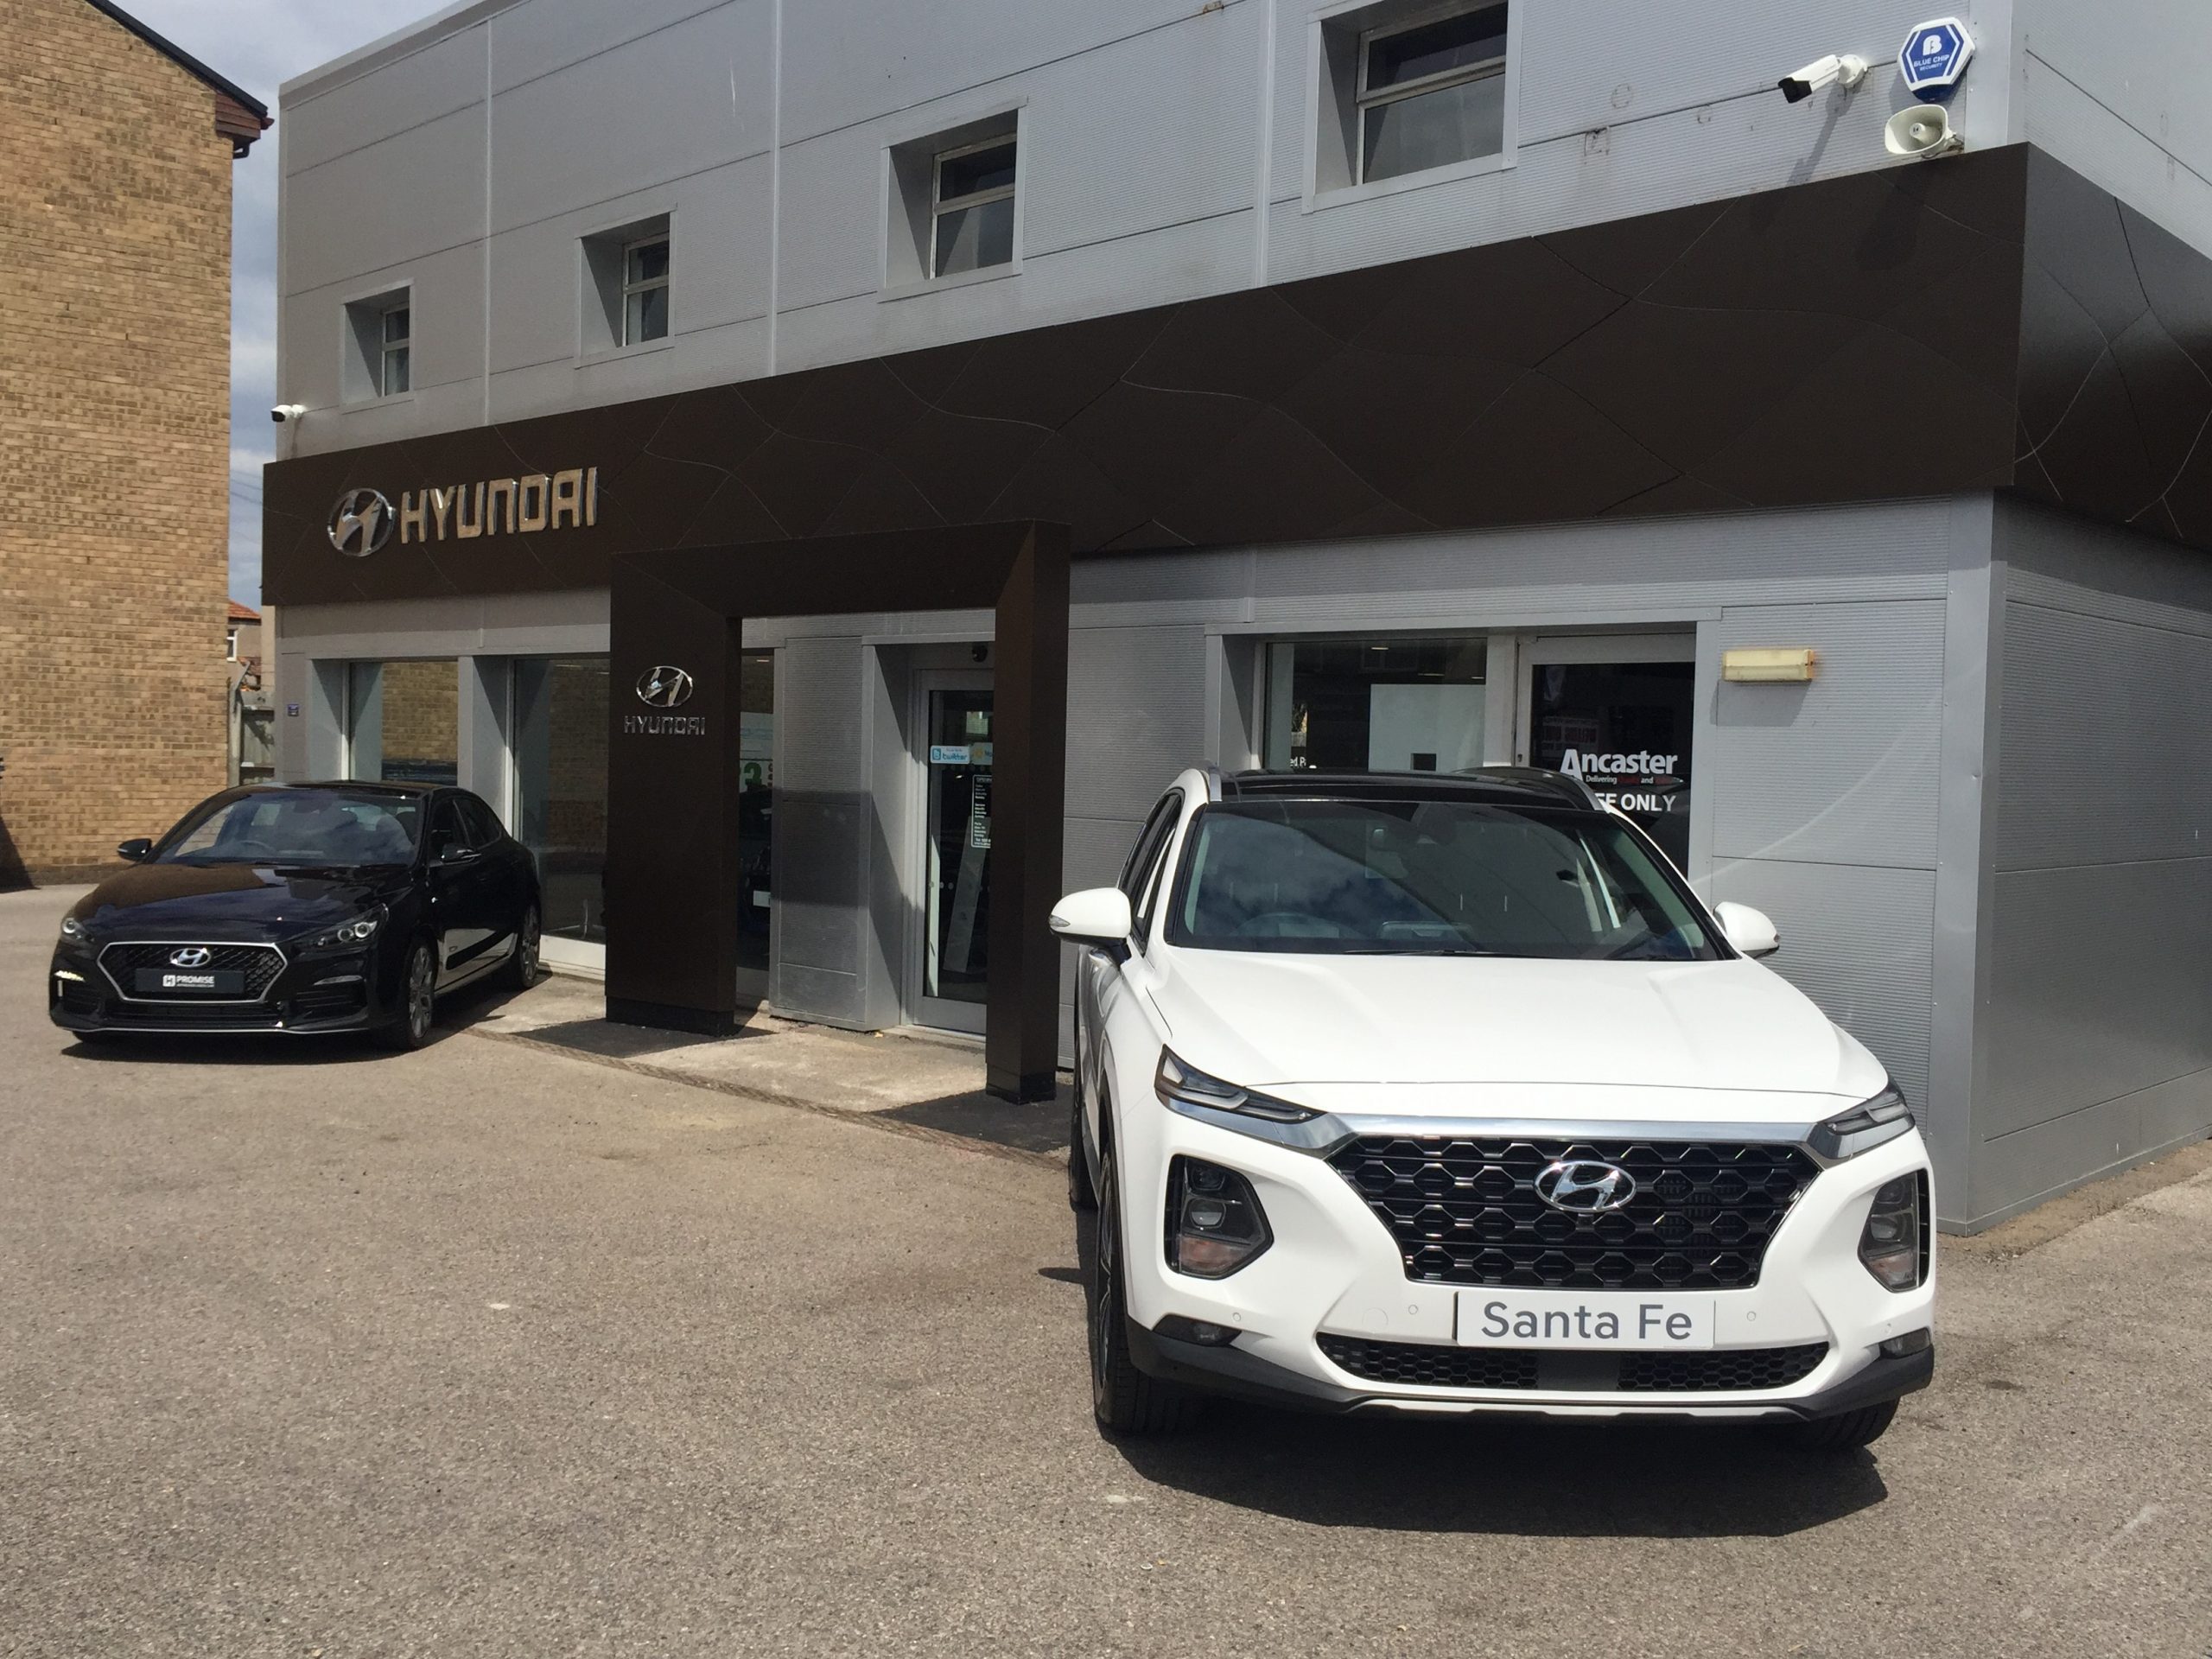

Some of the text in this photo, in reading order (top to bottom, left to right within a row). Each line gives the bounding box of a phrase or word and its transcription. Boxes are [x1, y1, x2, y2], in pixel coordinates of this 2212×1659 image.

[1913, 54, 1950, 67] BLUE CHIP
[1919, 62, 1943, 71] SECURITY
[401, 467, 598, 544] HYUNDAI
[624, 715, 706, 735] HYUNDAI
[942, 752, 968, 760] twitter
[1560, 748, 1678, 781] Ancaster
[1586, 775, 1618, 785] Delivering
[1620, 793, 1676, 812] ONLY
[176, 976, 214, 984] PROMISE
[1481, 1301, 1693, 1340] Santa Fe
